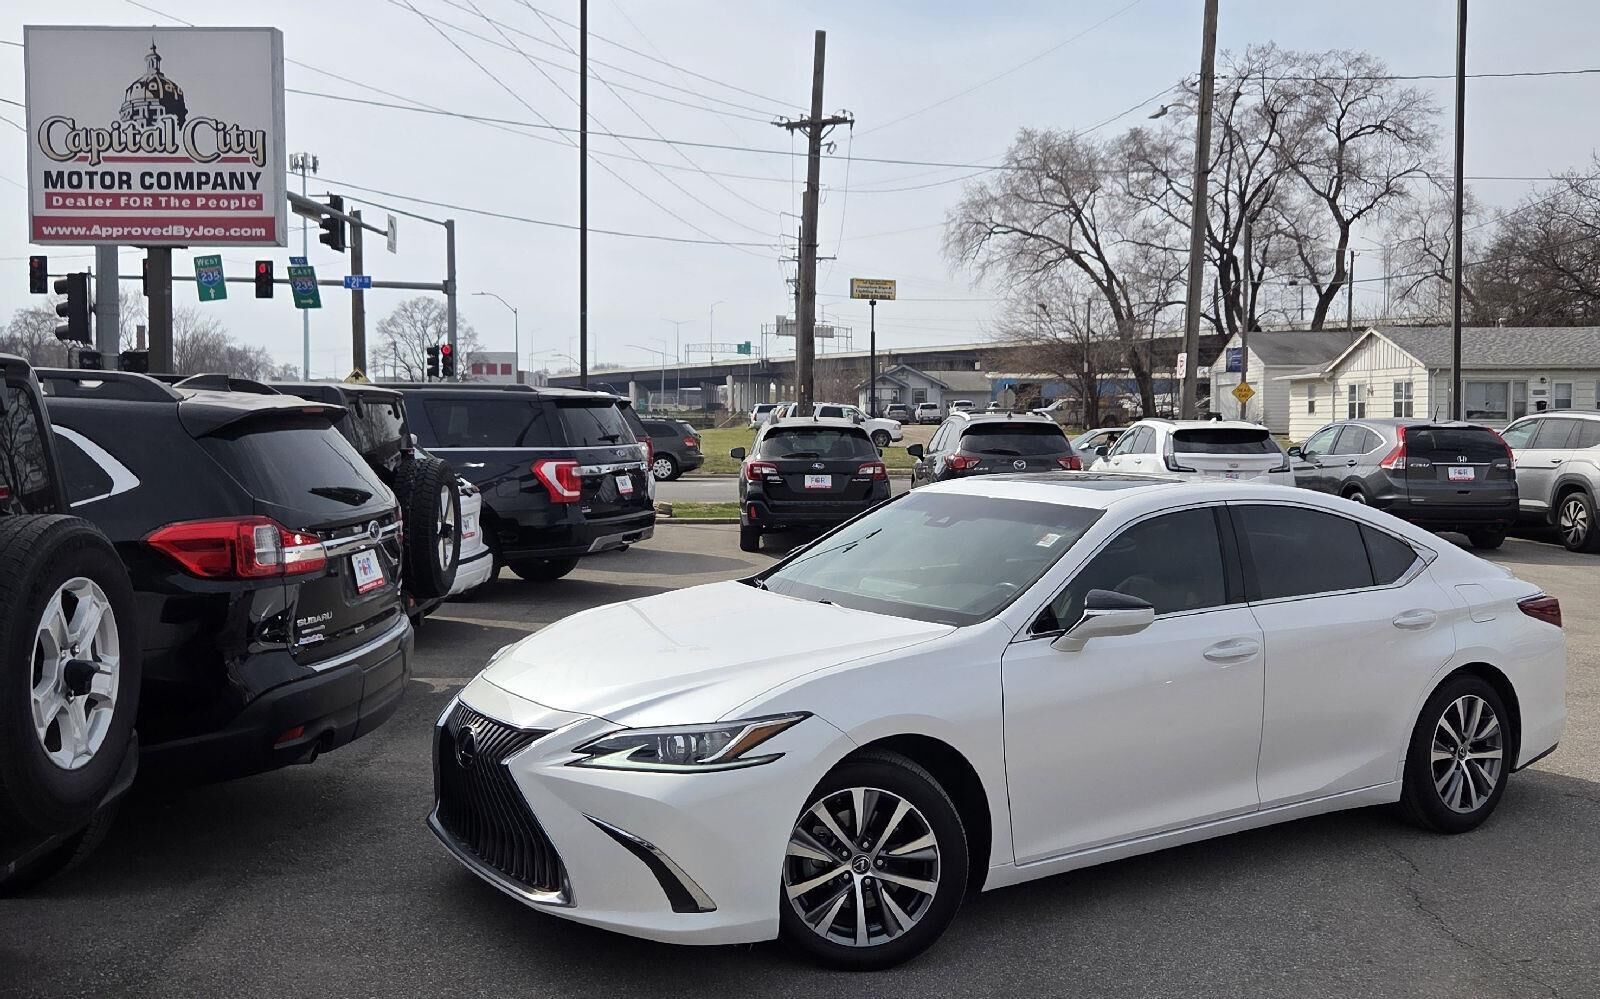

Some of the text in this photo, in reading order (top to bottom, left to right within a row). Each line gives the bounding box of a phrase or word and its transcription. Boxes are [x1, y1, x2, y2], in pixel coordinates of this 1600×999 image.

[38, 115, 267, 168] Capital City
[43, 170, 262, 191] MOTOR COMPANY
[52, 195, 257, 210] Dealer FOR The People
[42, 224, 266, 238] www.ApprovedByJoe.com
[196, 257, 219, 267] WEST
[200, 271, 220, 282] 235
[291, 268, 313, 276] EAST
[295, 279, 314, 291] 235
[296, 611, 333, 628] SUBARU
